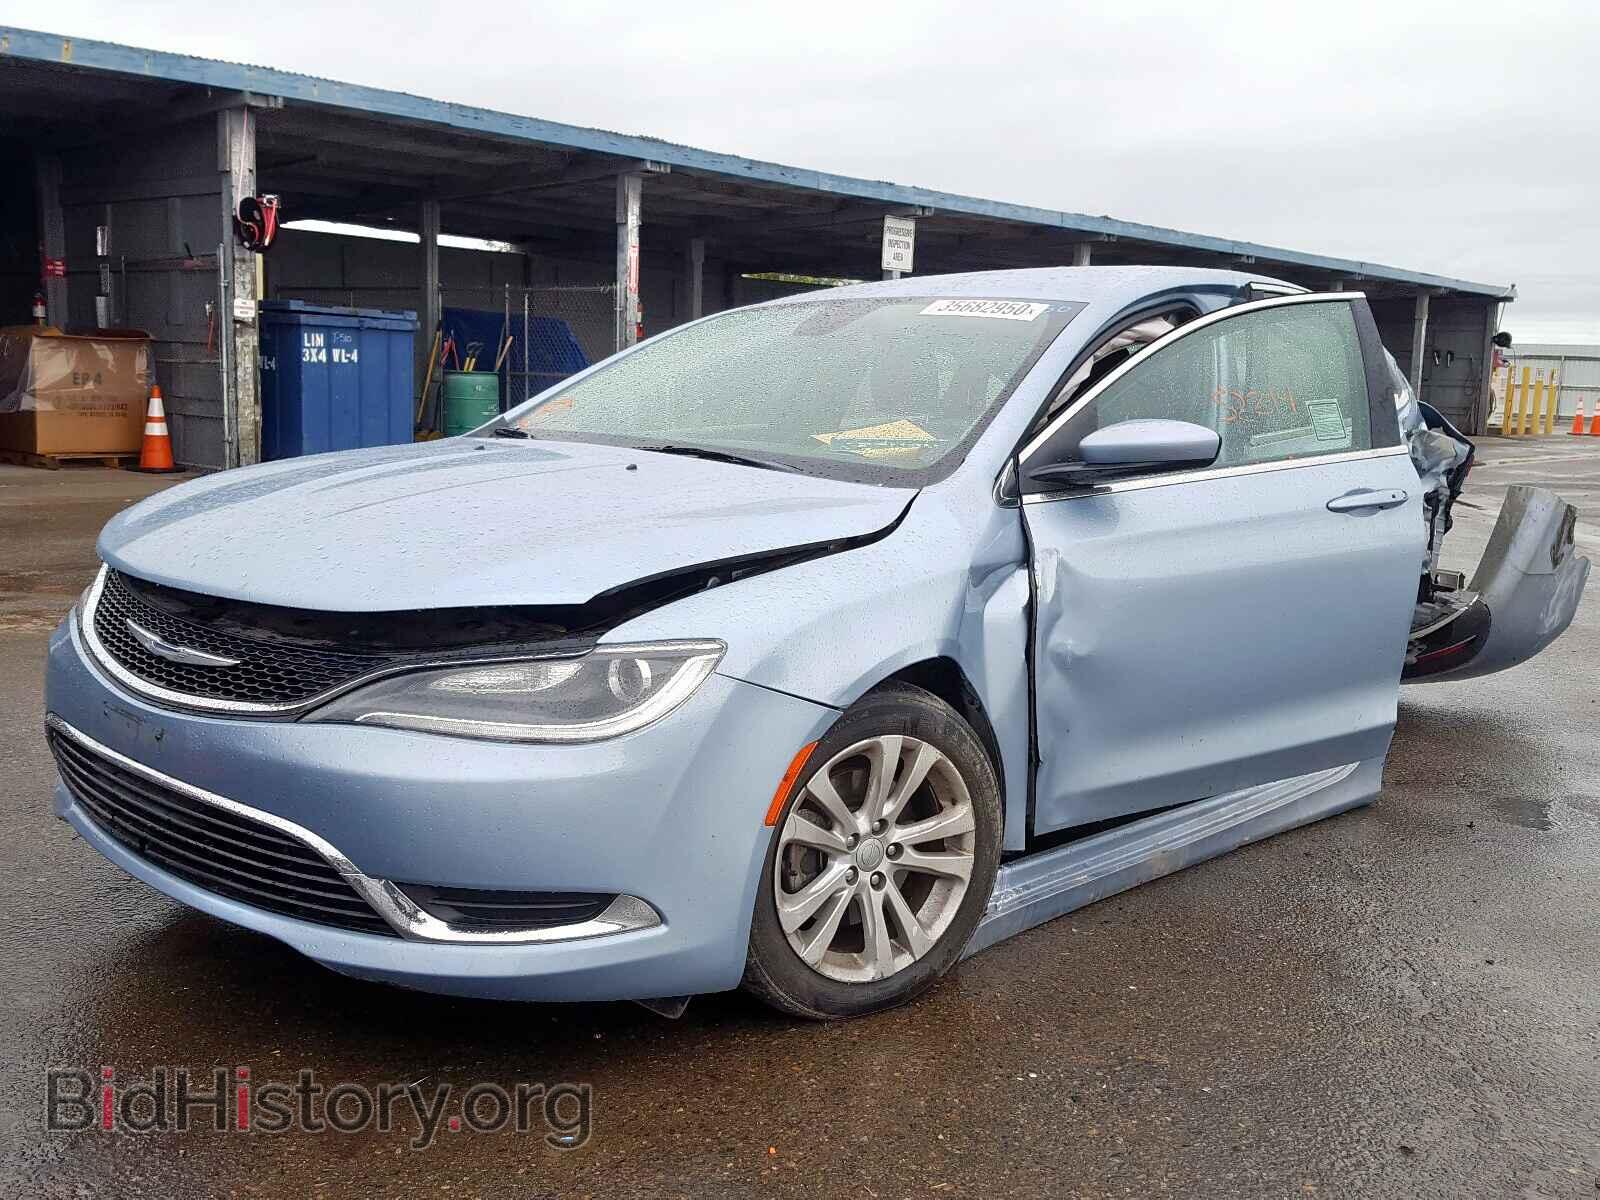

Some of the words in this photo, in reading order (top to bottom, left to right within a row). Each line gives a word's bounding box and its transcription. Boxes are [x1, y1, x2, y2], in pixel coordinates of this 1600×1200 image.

[886, 225, 913, 238] PROGRESSIVE
[887, 238, 911, 250] INSPECTION
[892, 252, 904, 262] AREA
[302, 348, 327, 363] 3X4
[332, 348, 358, 363] WL-4
